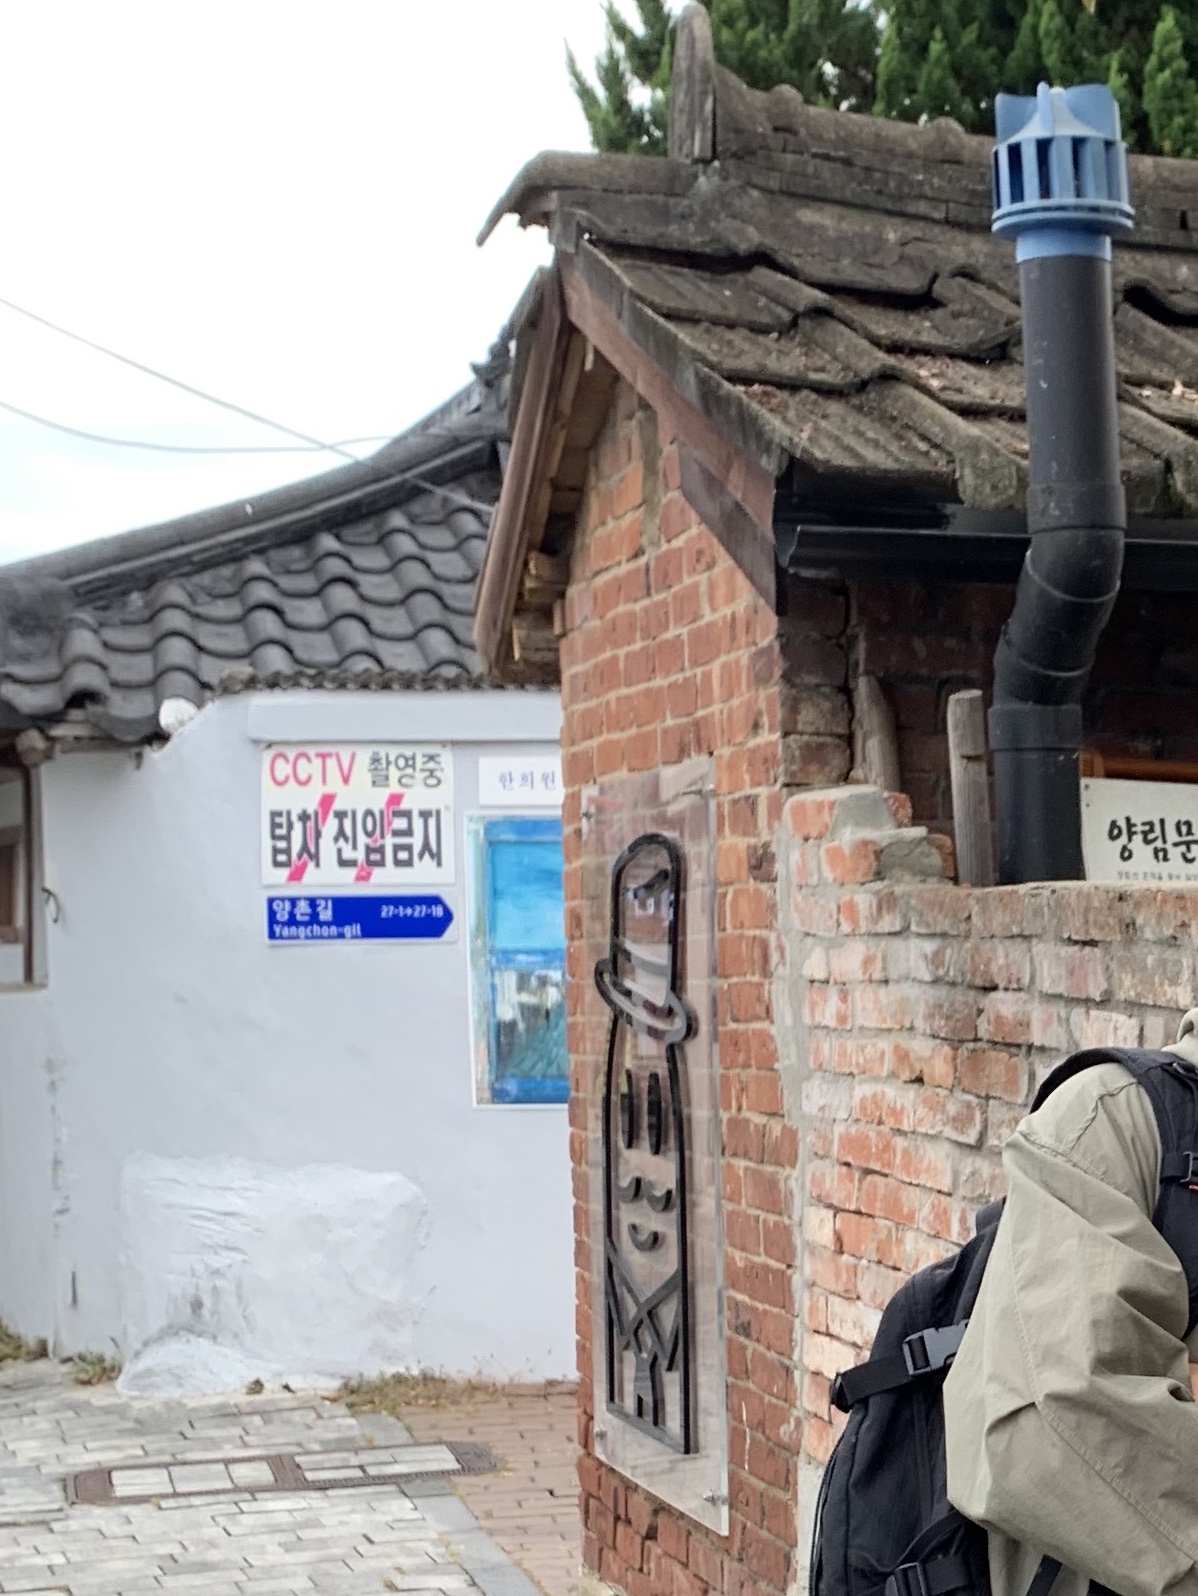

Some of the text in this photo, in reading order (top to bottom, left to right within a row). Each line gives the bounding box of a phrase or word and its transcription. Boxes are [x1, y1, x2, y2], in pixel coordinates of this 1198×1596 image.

[269, 750, 444, 788] CCTV 촬영중
[269, 808, 443, 868] 탑차 진입금지
[272, 898, 334, 922] 양촌길
[273, 923, 362, 939] Yangchon-gil
